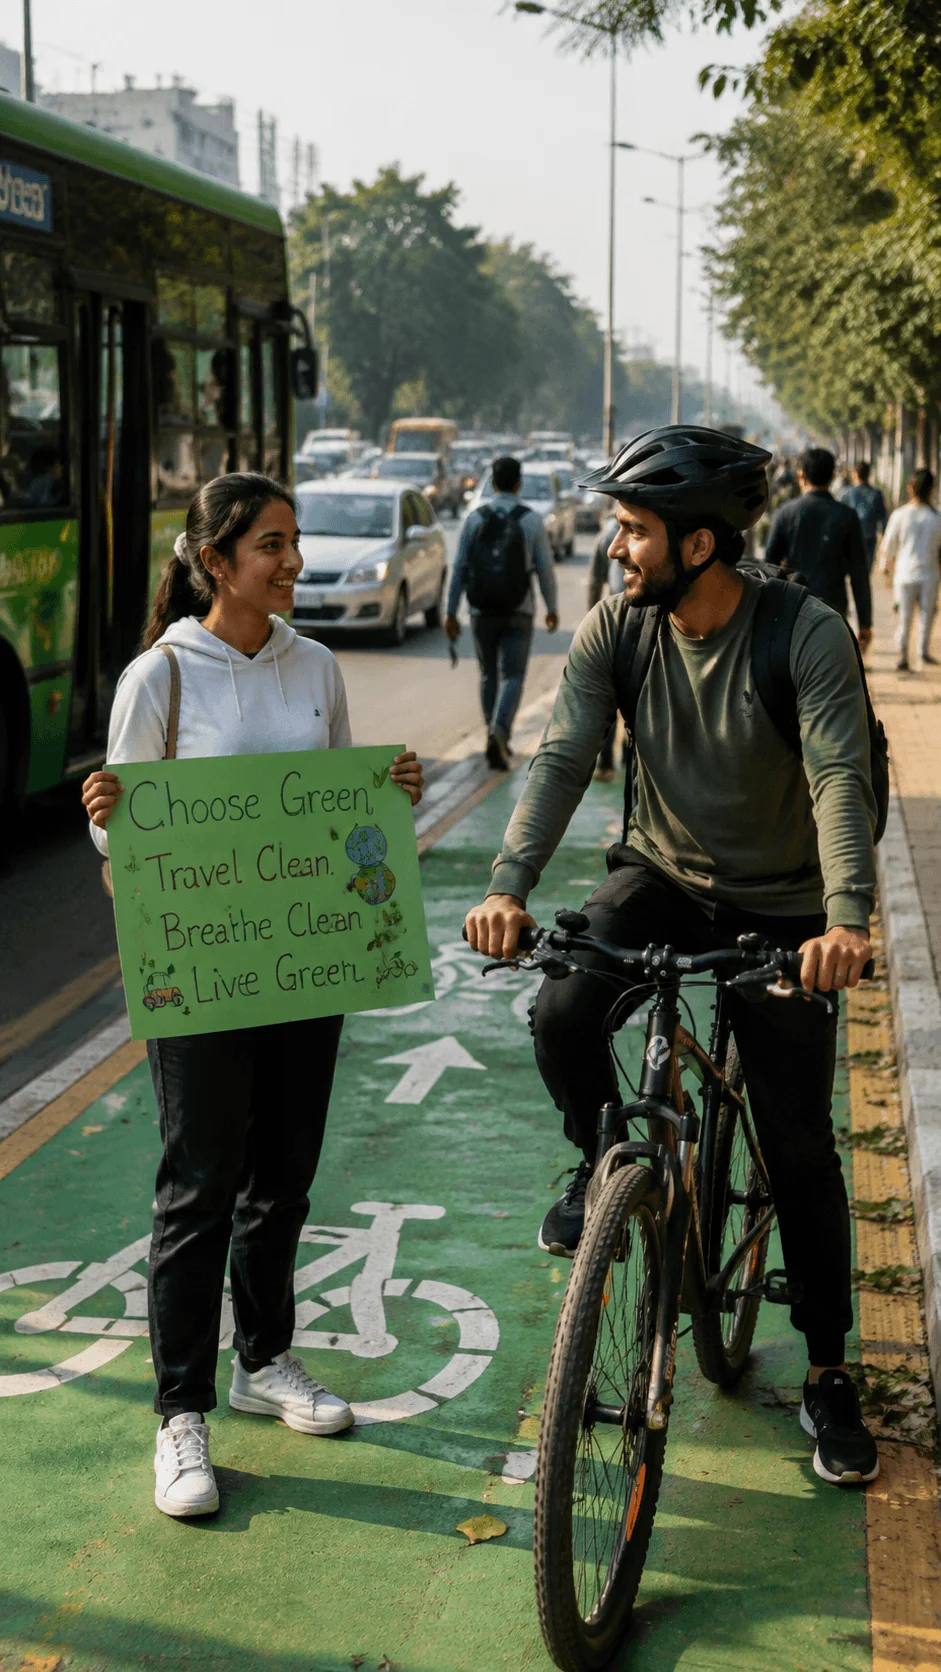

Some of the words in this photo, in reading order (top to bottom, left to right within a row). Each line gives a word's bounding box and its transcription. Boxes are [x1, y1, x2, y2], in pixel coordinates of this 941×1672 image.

[129, 780, 262, 831] Choose
[280, 771, 374, 816] Green
[145, 848, 243, 892] Travel
[256, 843, 334, 882] Clean.
[160, 908, 274, 951] Breathe
[287, 902, 362, 937] Clean
[192, 966, 260, 1003] Live
[275, 953, 365, 991] Green
